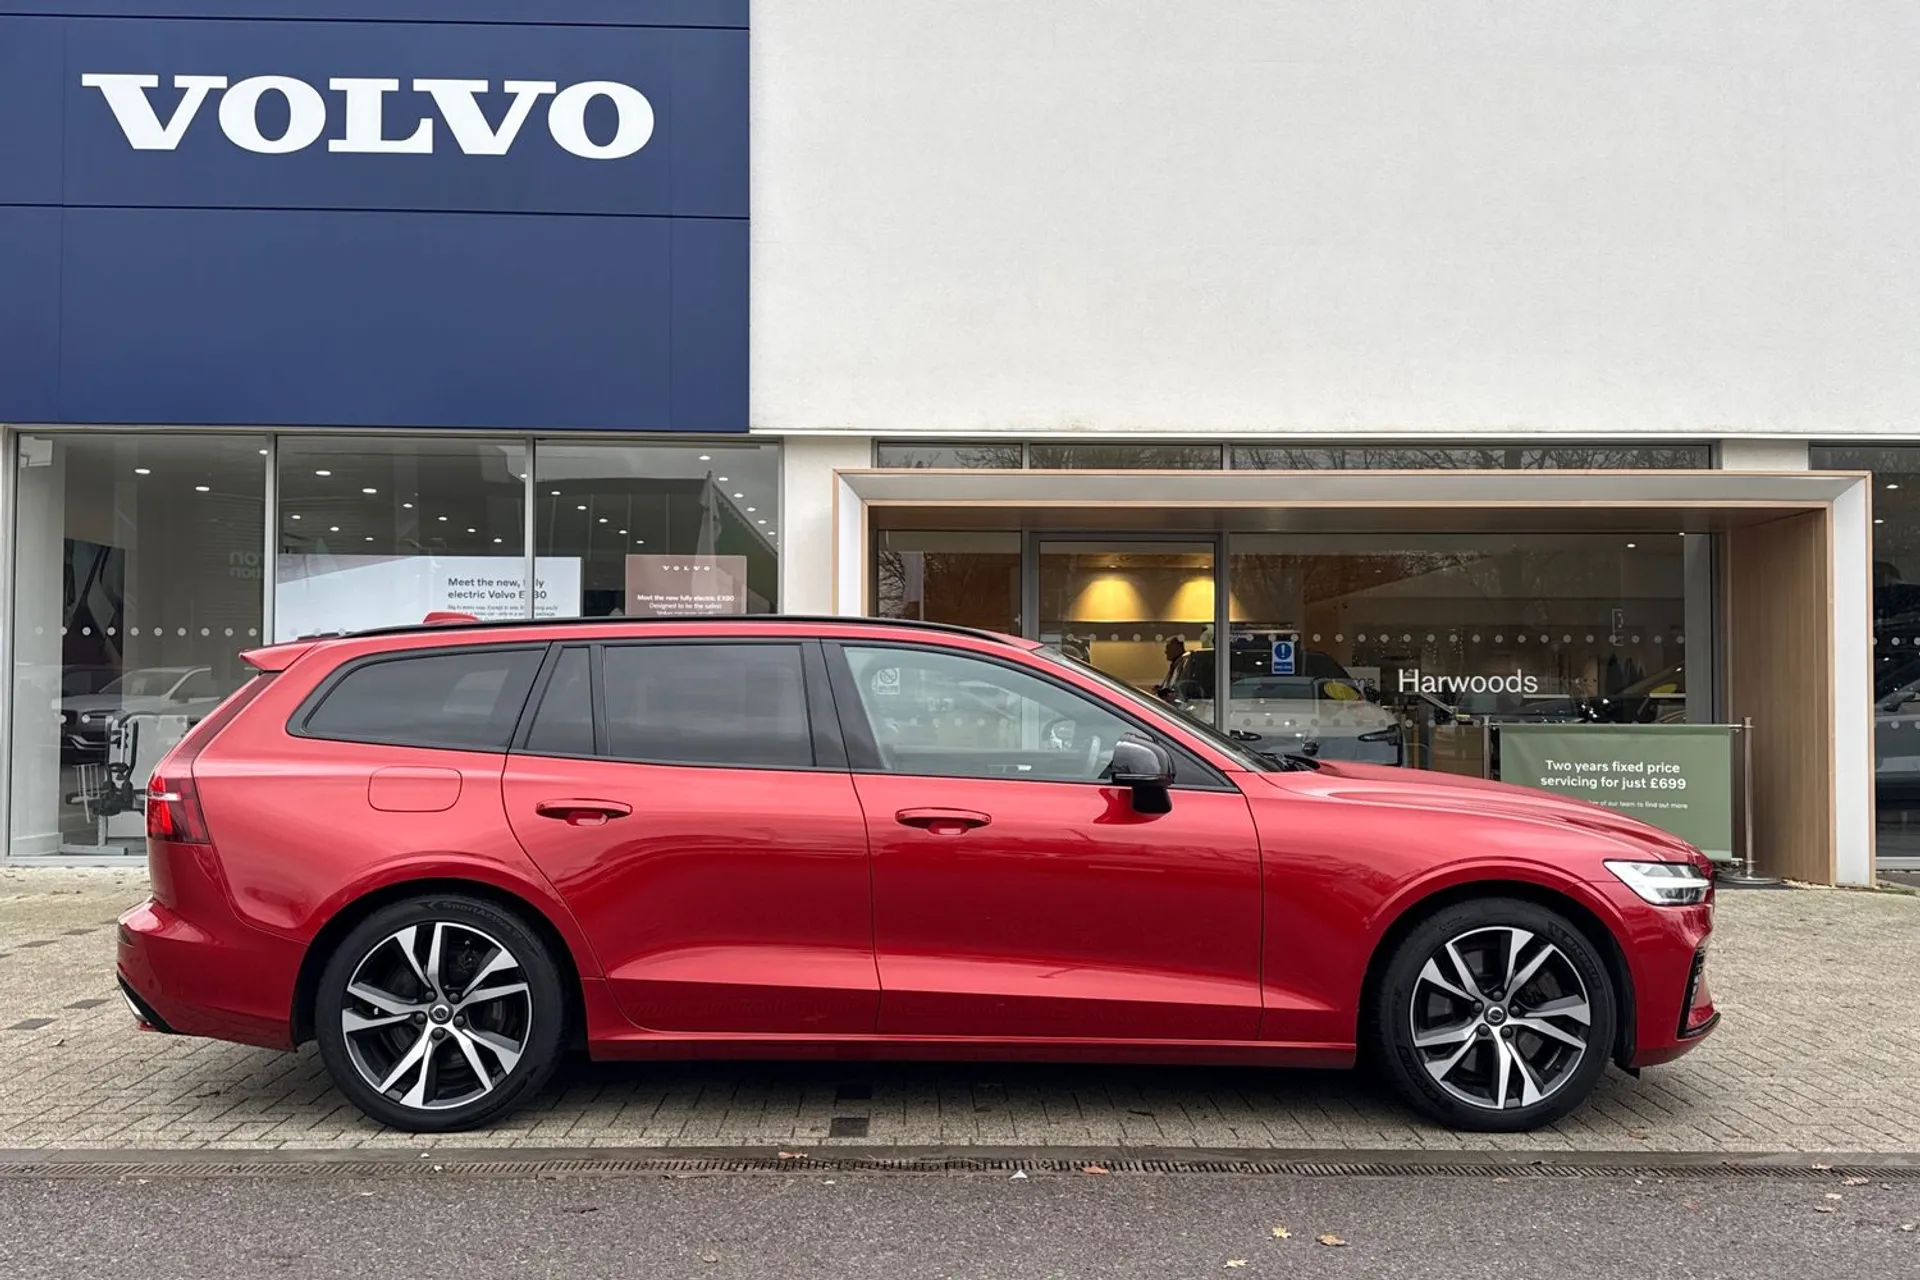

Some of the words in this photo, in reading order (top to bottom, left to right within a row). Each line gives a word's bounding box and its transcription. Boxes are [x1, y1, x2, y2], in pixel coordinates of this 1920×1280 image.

[82, 73, 654, 159] VOLVO
[448, 578, 475, 587] Meet
[477, 578, 494, 587] the
[496, 579, 521, 589] new,
[448, 590, 485, 599] electric
[488, 590, 516, 599] Volvo
[518, 590, 547, 599] E30
[1398, 668, 1539, 693] Harwoods
[1545, 760, 1572, 771] Two
[1575, 761, 1609, 773] years
[1612, 760, 1644, 773] fixed
[1647, 762, 1681, 775] price
[1540, 776, 1598, 789] servicing
[1600, 776, 1620, 788] for
[1621, 778, 1647, 790] just
[1650, 778, 1687, 790] £699
